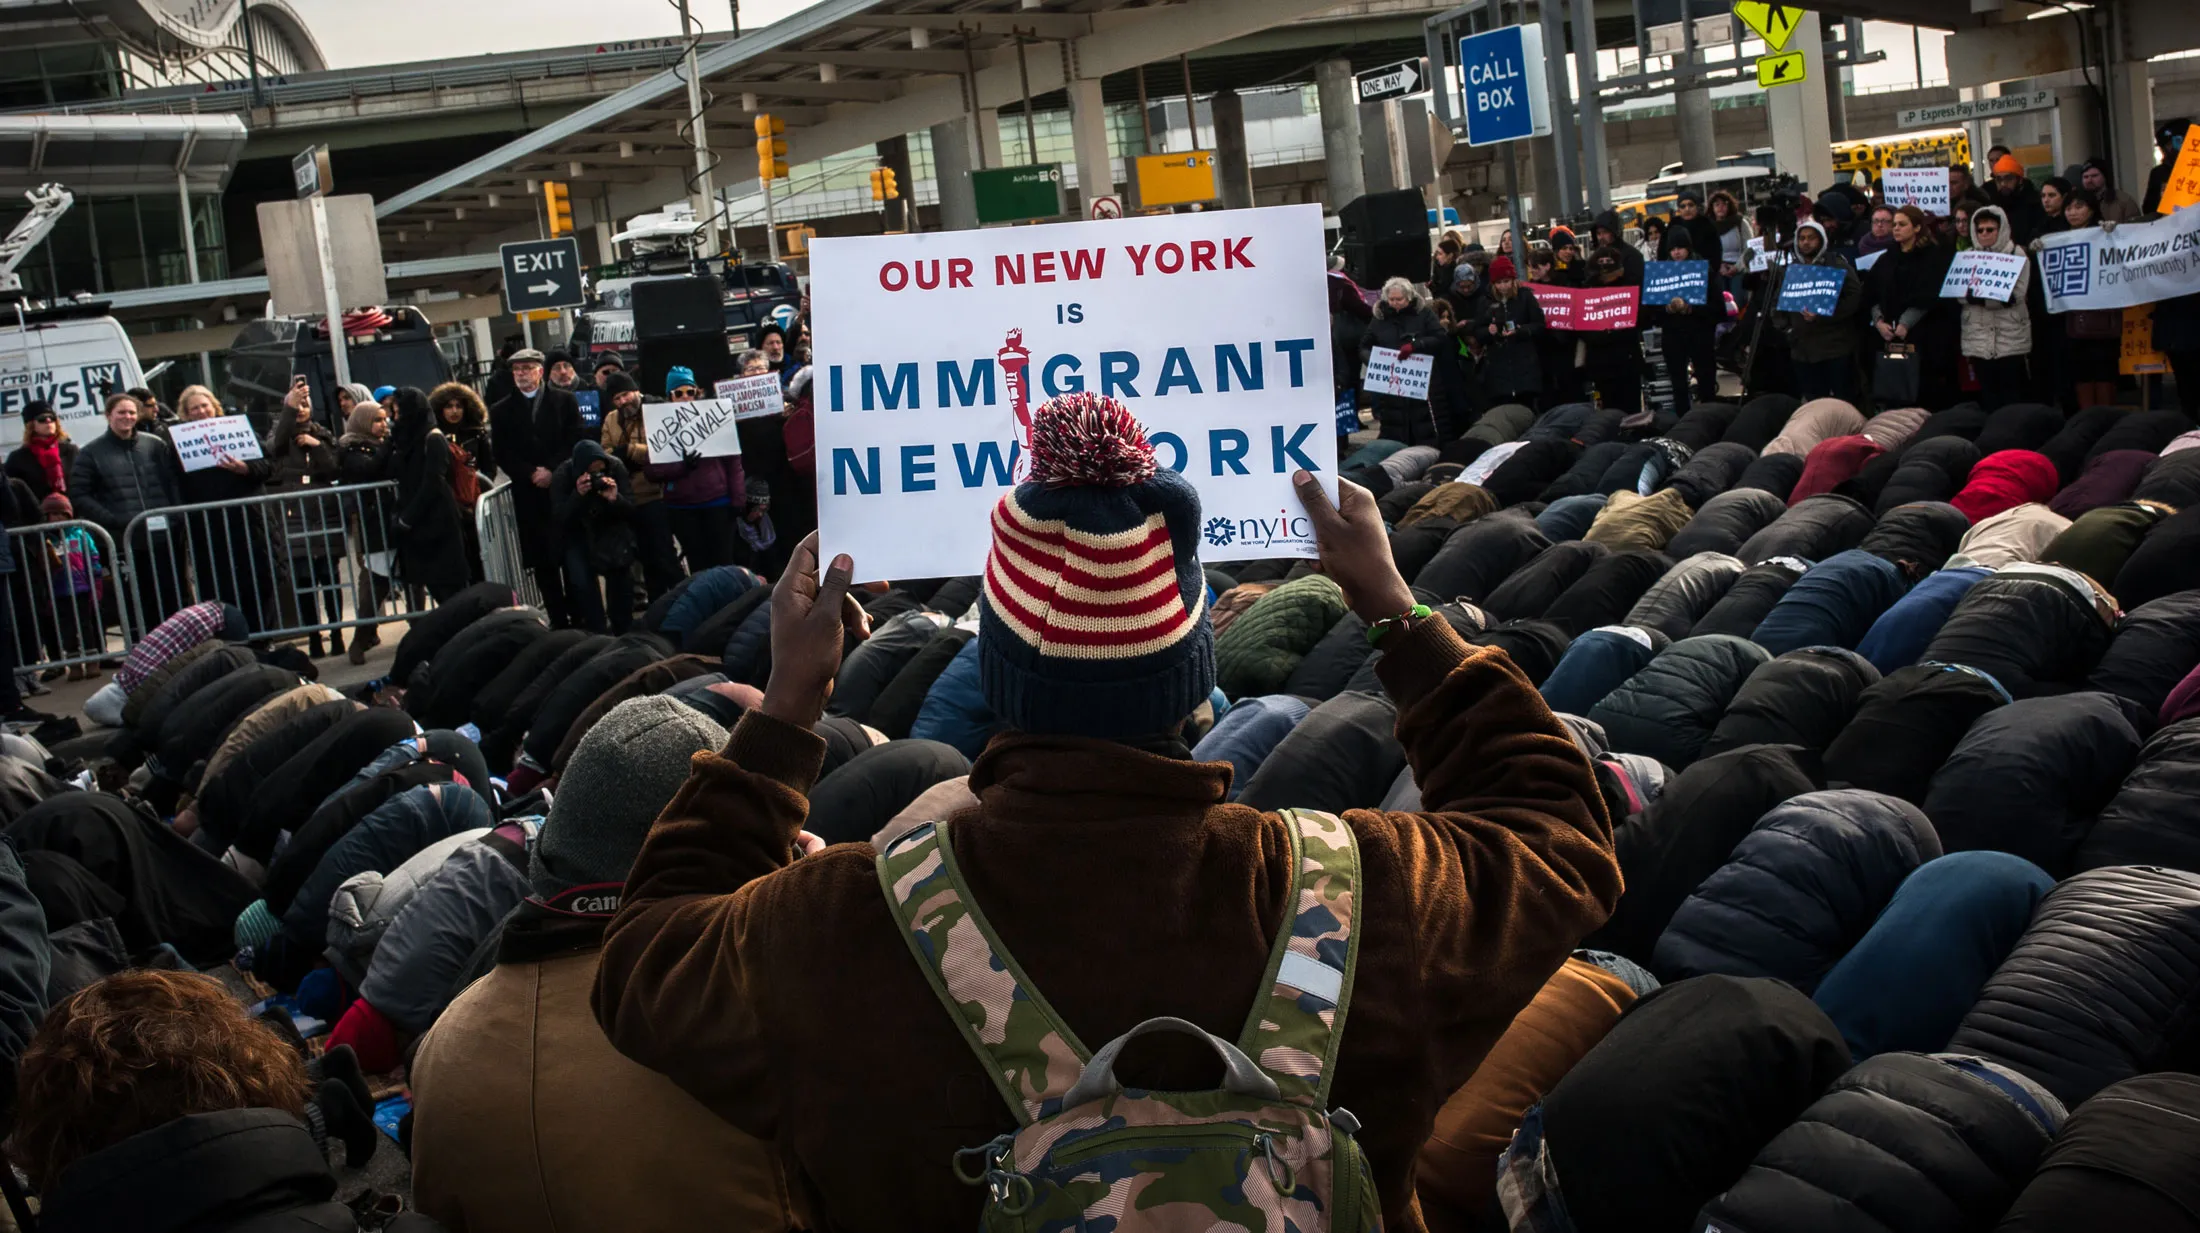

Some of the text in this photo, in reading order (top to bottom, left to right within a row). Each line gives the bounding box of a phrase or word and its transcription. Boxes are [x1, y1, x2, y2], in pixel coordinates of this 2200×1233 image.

[1469, 58, 1518, 85] CALL
[1363, 73, 1402, 95] ONE WAY
[1477, 86, 1515, 112] BOX
[1921, 106, 1956, 122] Express
[1957, 102, 1973, 116] Pay
[1975, 99, 1989, 112] for
[1991, 95, 2027, 110] Parking
[1887, 196, 1947, 205] NEW YORK
[513, 250, 566, 273] EXIT
[880, 236, 1256, 292] OUR NEW YORK
[2098, 269, 2120, 286] For
[2122, 257, 2186, 283] Community
[1655, 276, 1680, 285] STAND
[1681, 273, 1701, 281] WITH
[1791, 281, 1814, 290] STAND
[1946, 278, 2012, 290] NEW YORK
[1602, 292, 1632, 302] YORKERS
[1057, 303, 1084, 324] IS
[1583, 306, 1631, 321] JUSTICE!
[86, 365, 118, 385] NY
[1367, 372, 1428, 388] NEW YORK
[648, 402, 700, 453] NO BAN
[669, 401, 732, 458] NO WALL
[181, 440, 255, 460] NEW YORK
[833, 423, 1321, 495] NEW ORK
[1240, 508, 1309, 548] nyic
[571, 896, 622, 913] Can
